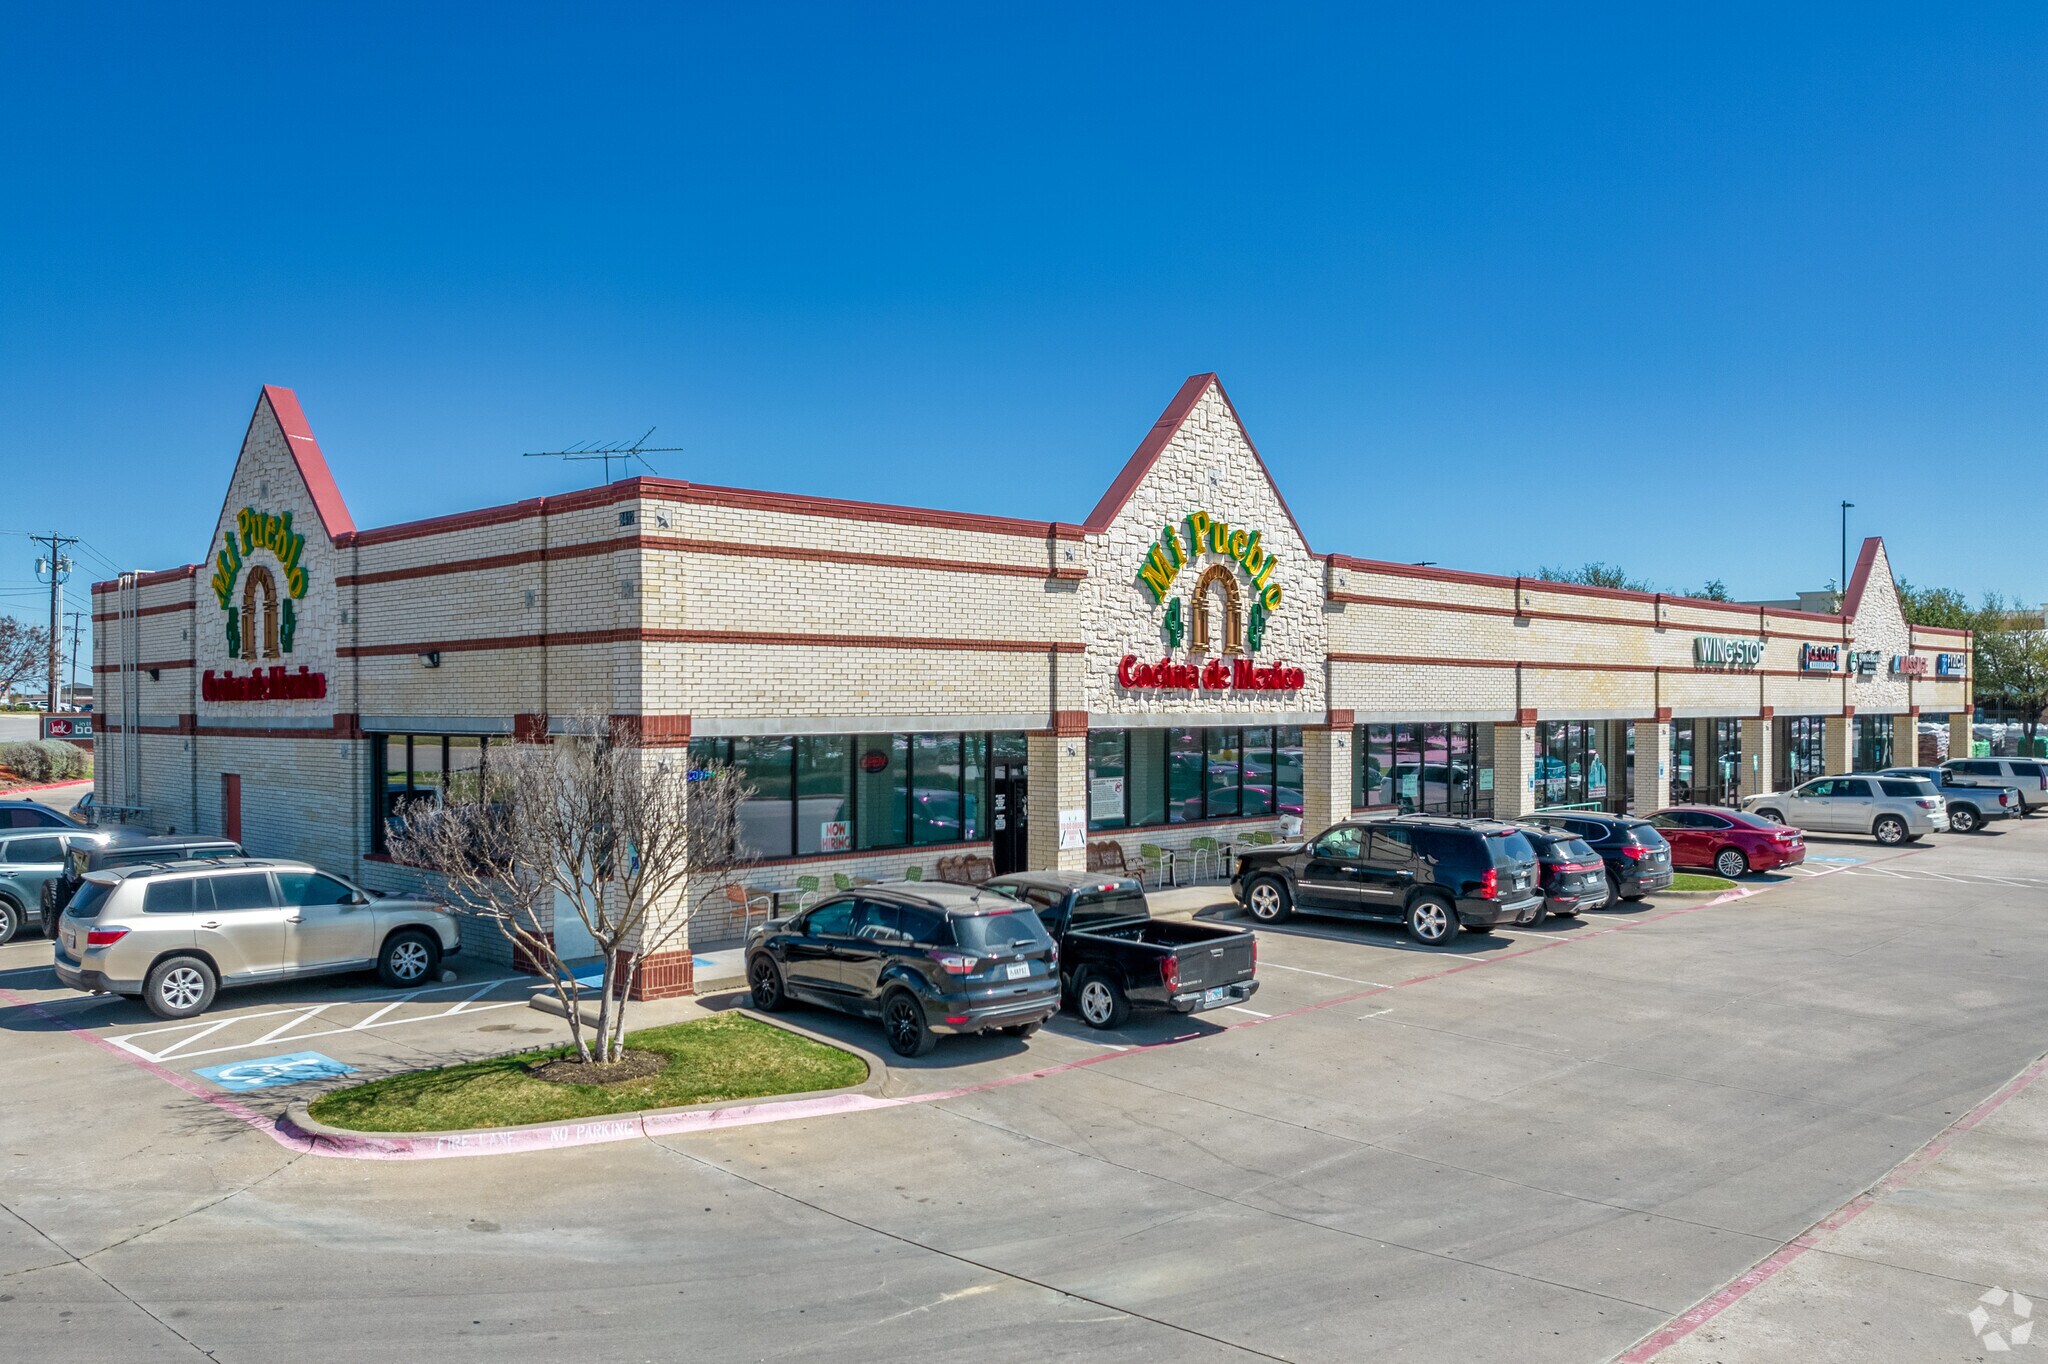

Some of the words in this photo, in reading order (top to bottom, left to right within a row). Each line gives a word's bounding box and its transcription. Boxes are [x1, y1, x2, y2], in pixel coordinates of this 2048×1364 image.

[212, 532, 242, 610] Mi
[237, 507, 309, 599] Pueblo
[1137, 524, 1187, 604] Mi
[1187, 510, 1282, 611] Pueblo
[1118, 654, 1199, 689] Cocina
[1202, 657, 1231, 689] de
[1233, 659, 1305, 690] Mexico
[50, 721, 72, 734] Jack
[75, 725, 92, 734] bo
[861, 756, 886, 768] OPEN
[826, 823, 846, 837] NOW
[822, 836, 850, 850] HIRING
[437, 1135, 468, 1151] FIRE
[550, 1127, 568, 1142] NO
[576, 1121, 634, 1140] PARKING
